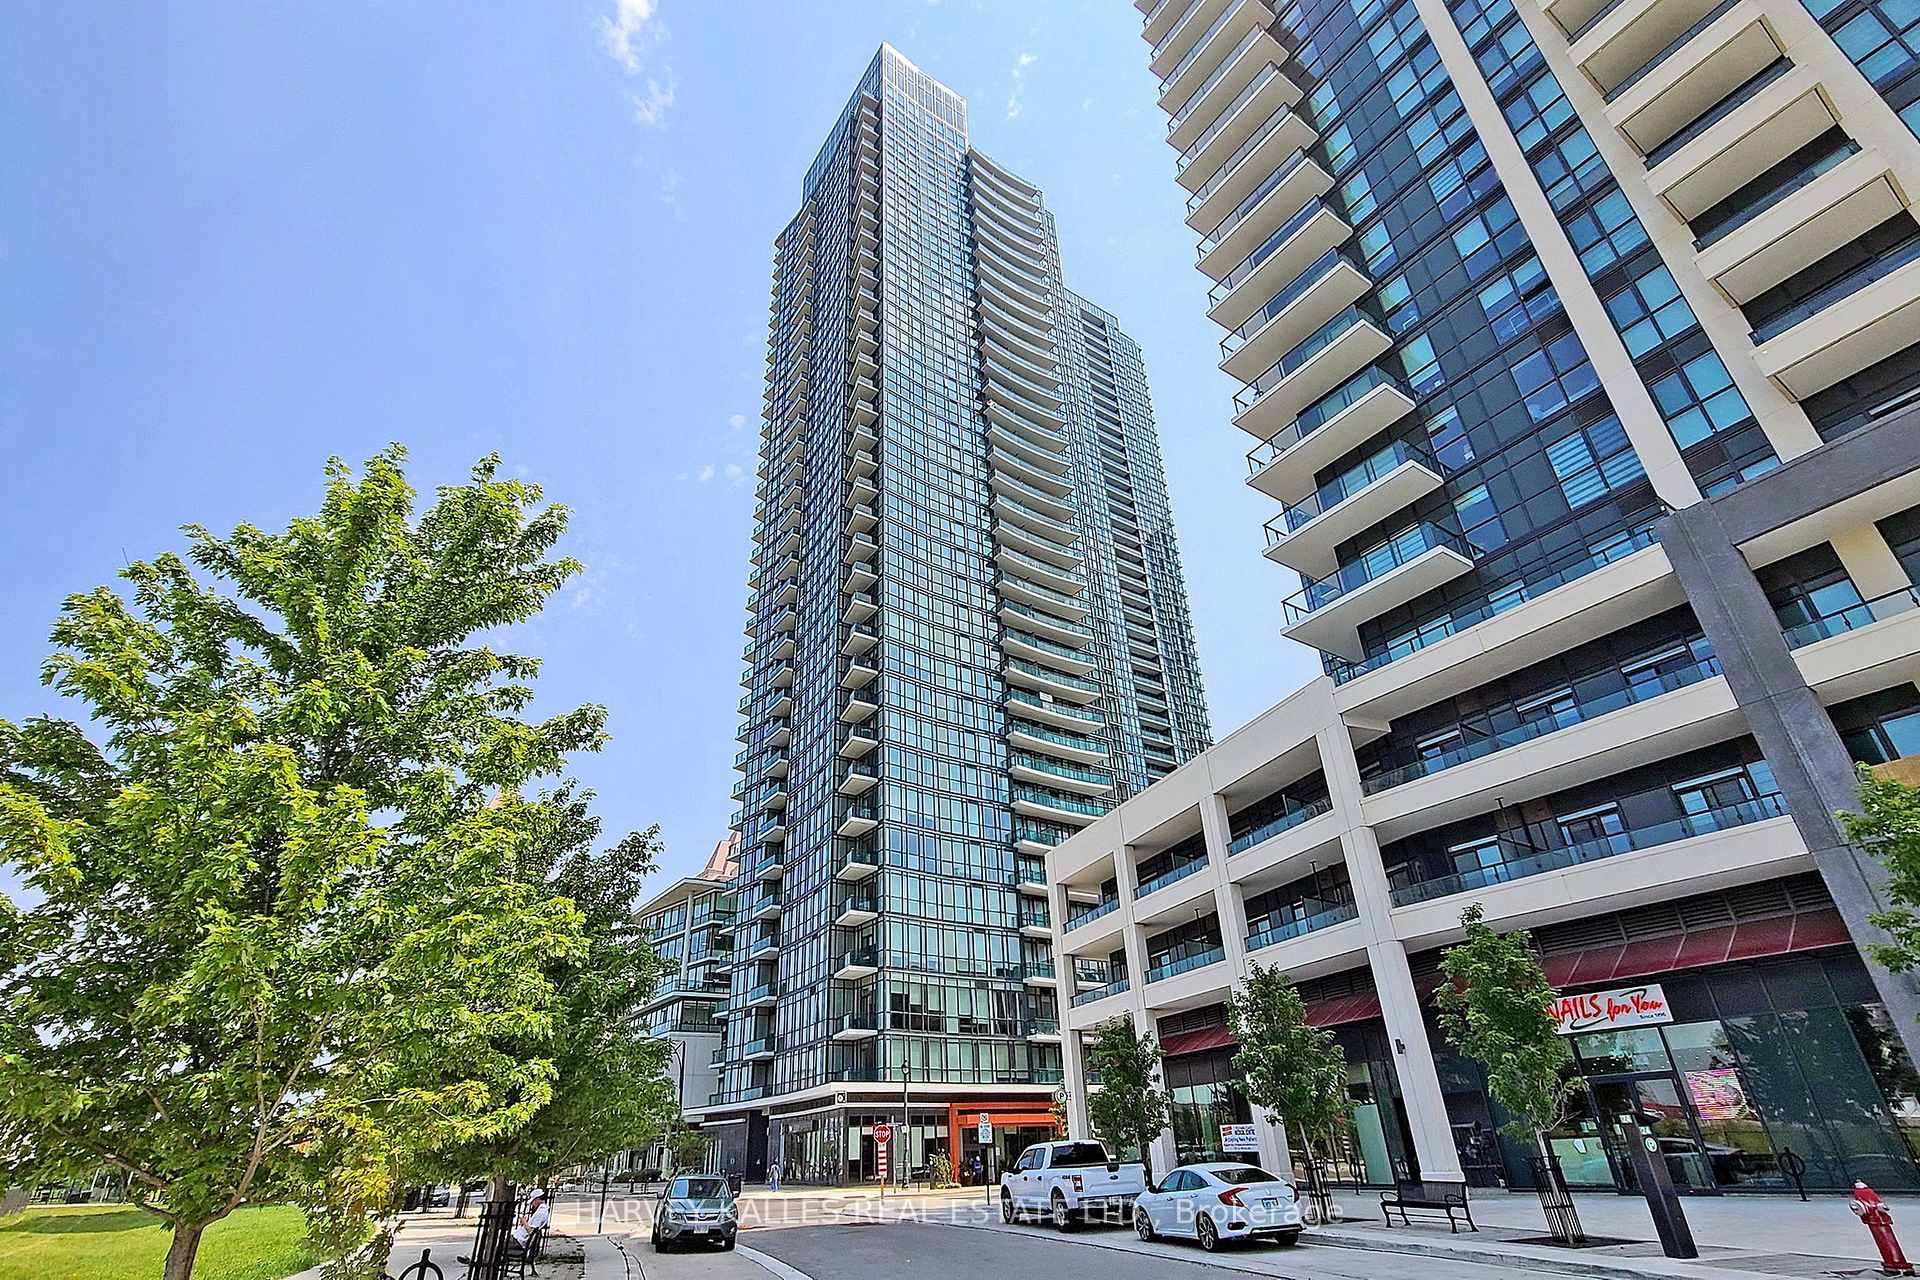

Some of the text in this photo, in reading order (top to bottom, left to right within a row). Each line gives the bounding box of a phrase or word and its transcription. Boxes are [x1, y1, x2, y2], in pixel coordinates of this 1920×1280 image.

[1607, 998, 1632, 1022] for
[1631, 994, 1663, 1013] You
[875, 1130, 889, 1139] STOP
